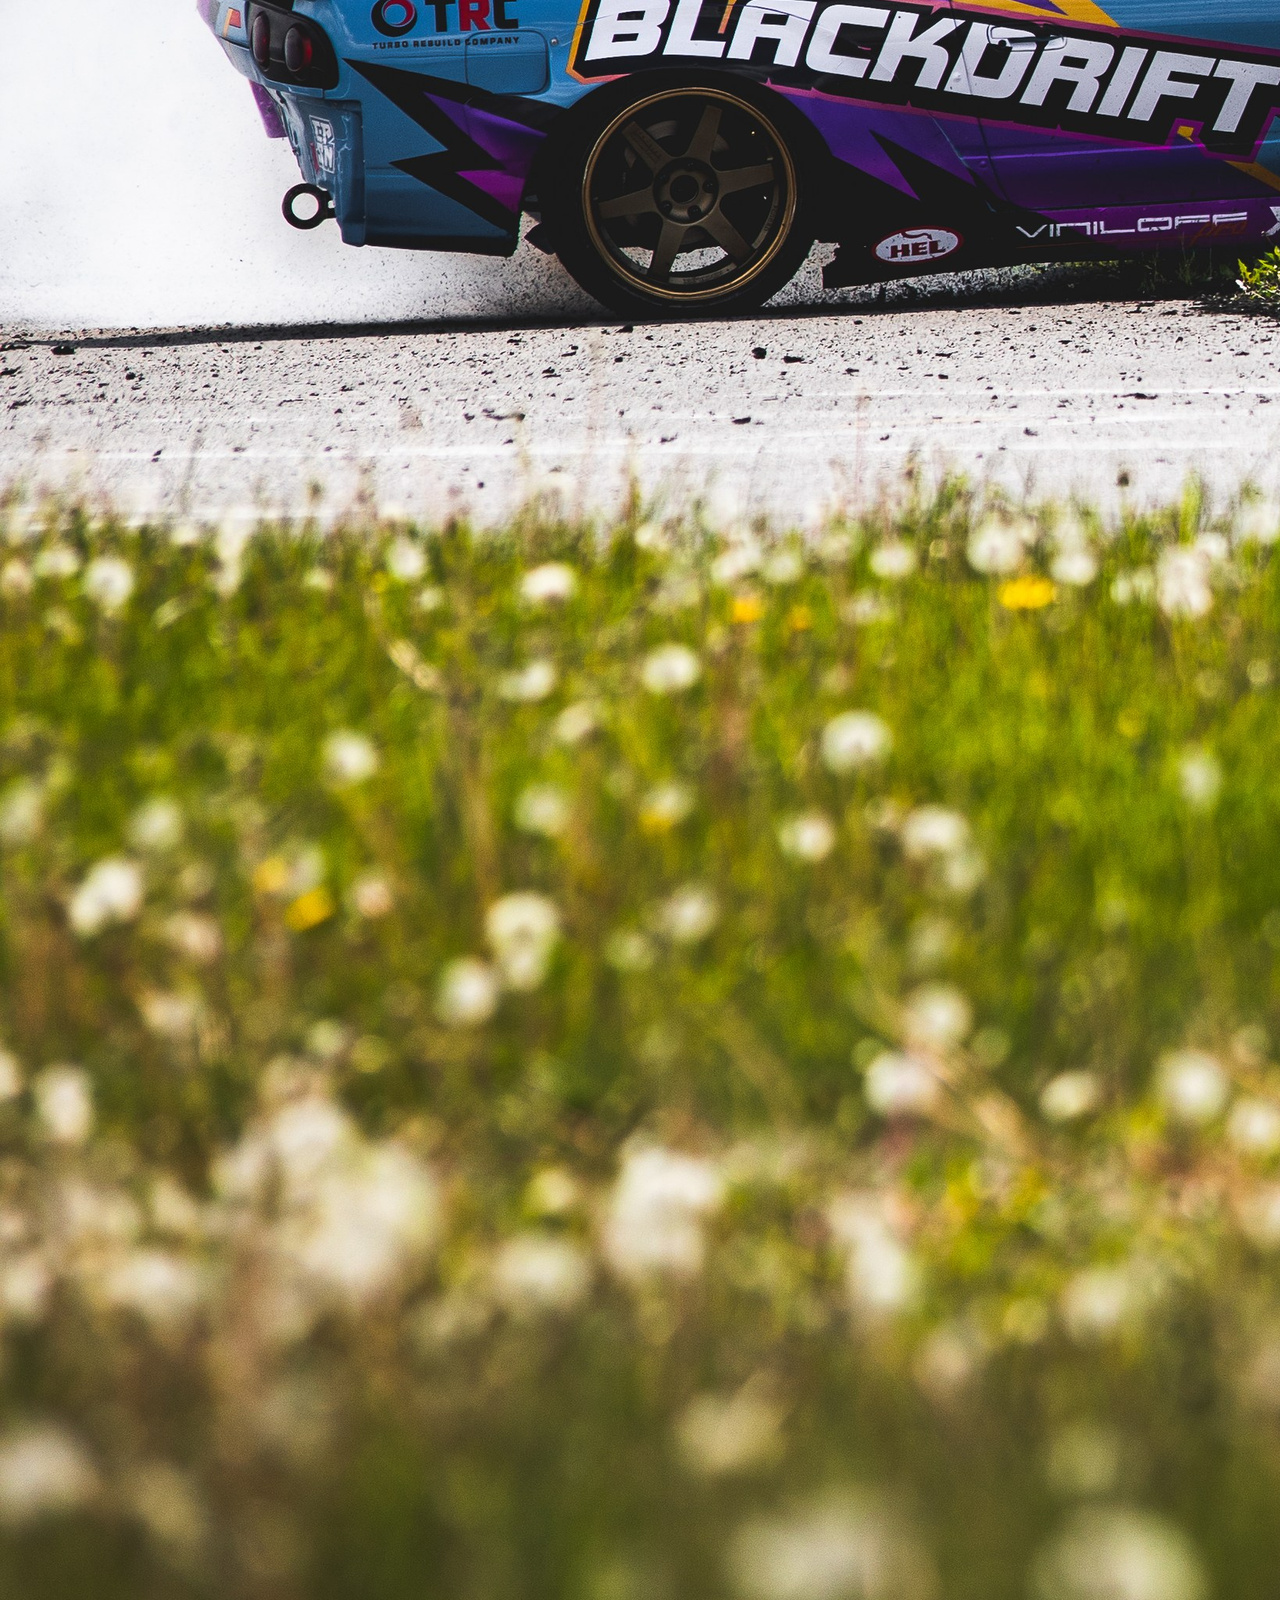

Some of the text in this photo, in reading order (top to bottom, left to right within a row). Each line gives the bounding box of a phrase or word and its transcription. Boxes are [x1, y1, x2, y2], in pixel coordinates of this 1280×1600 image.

[372, 36, 520, 50] TURBO REBUILD COMPANY
[888, 240, 947, 260] HEL
